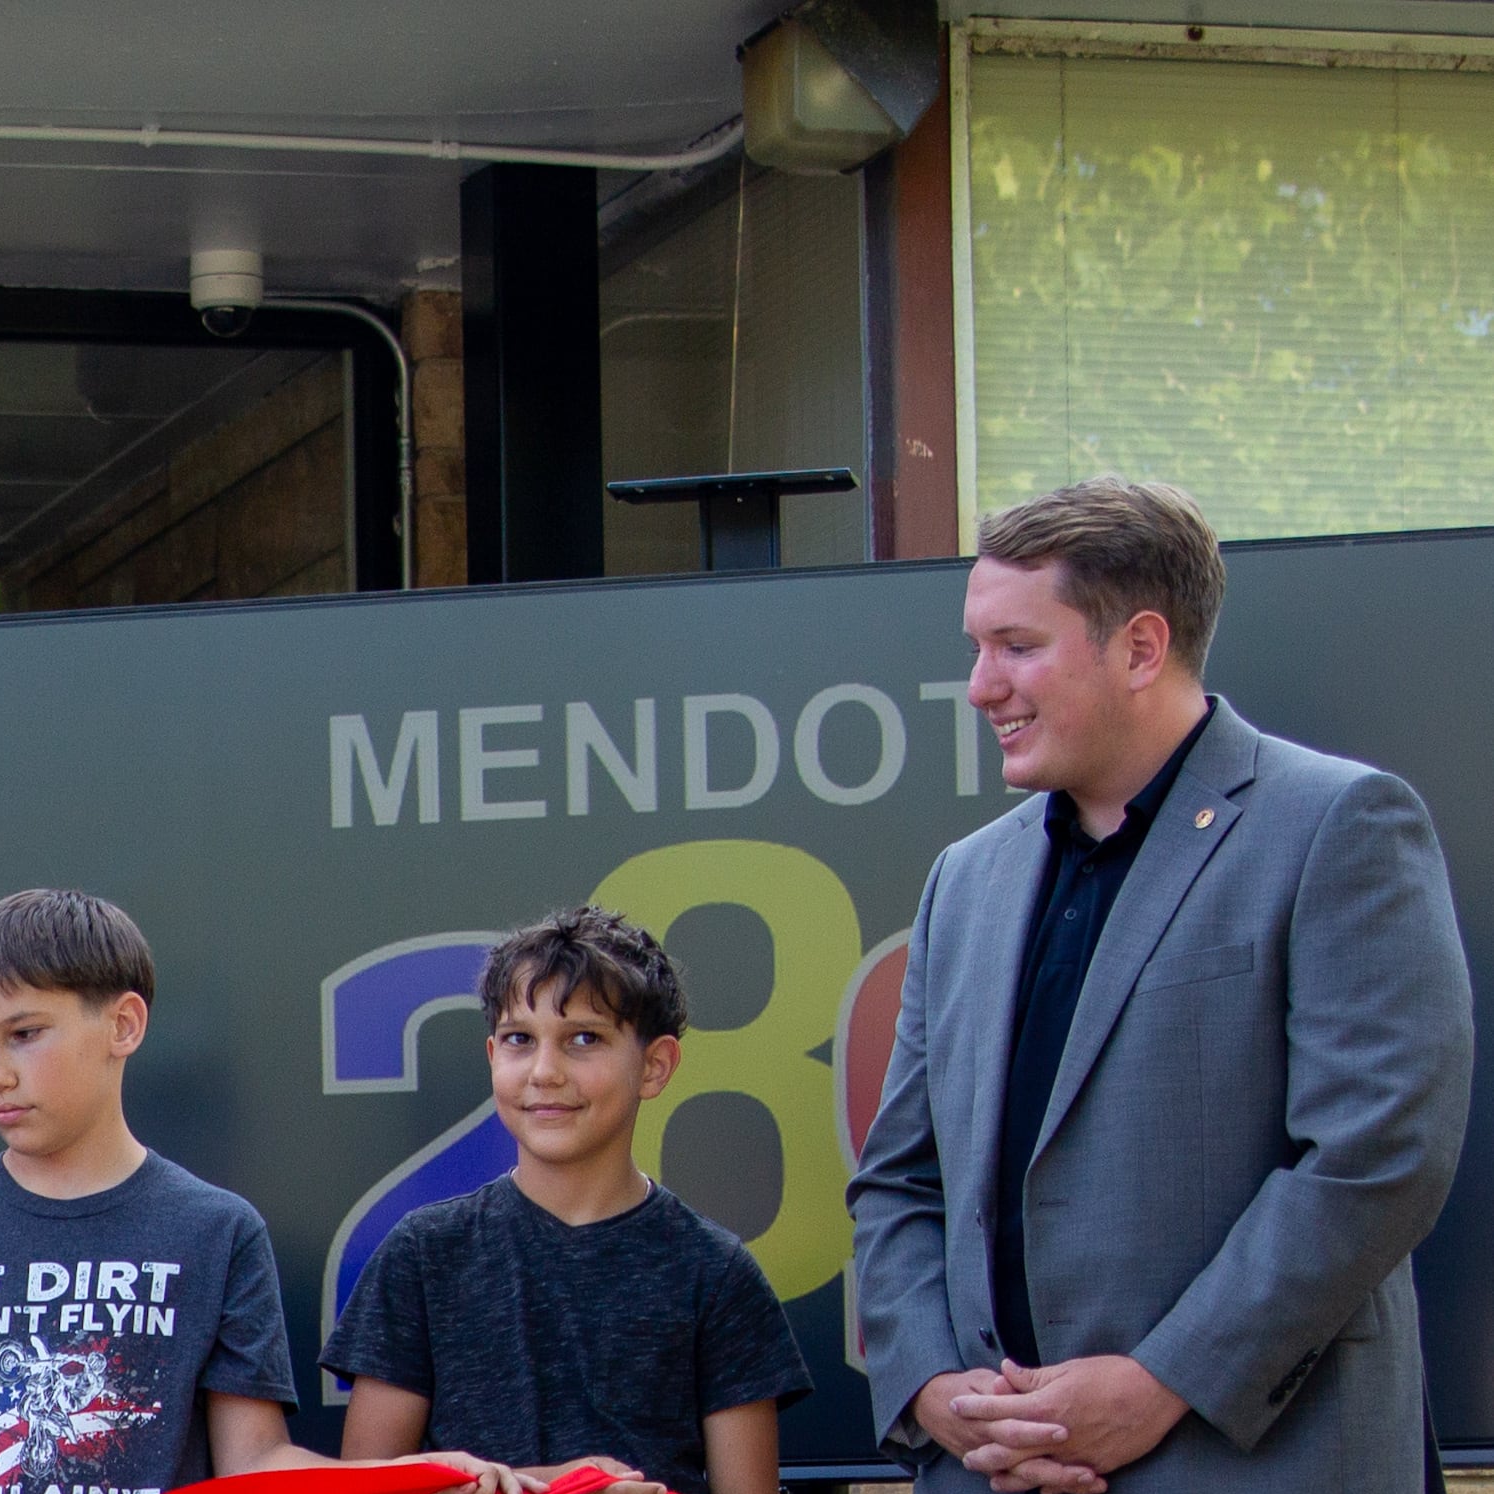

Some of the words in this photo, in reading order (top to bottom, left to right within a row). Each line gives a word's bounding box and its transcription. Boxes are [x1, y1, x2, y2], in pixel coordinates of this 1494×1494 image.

[329, 680, 1026, 828] MENDOT
[321, 838, 909, 1406] 28
[26, 1261, 181, 1304] DIRT
[59, 1303, 176, 1337] FLYIN
